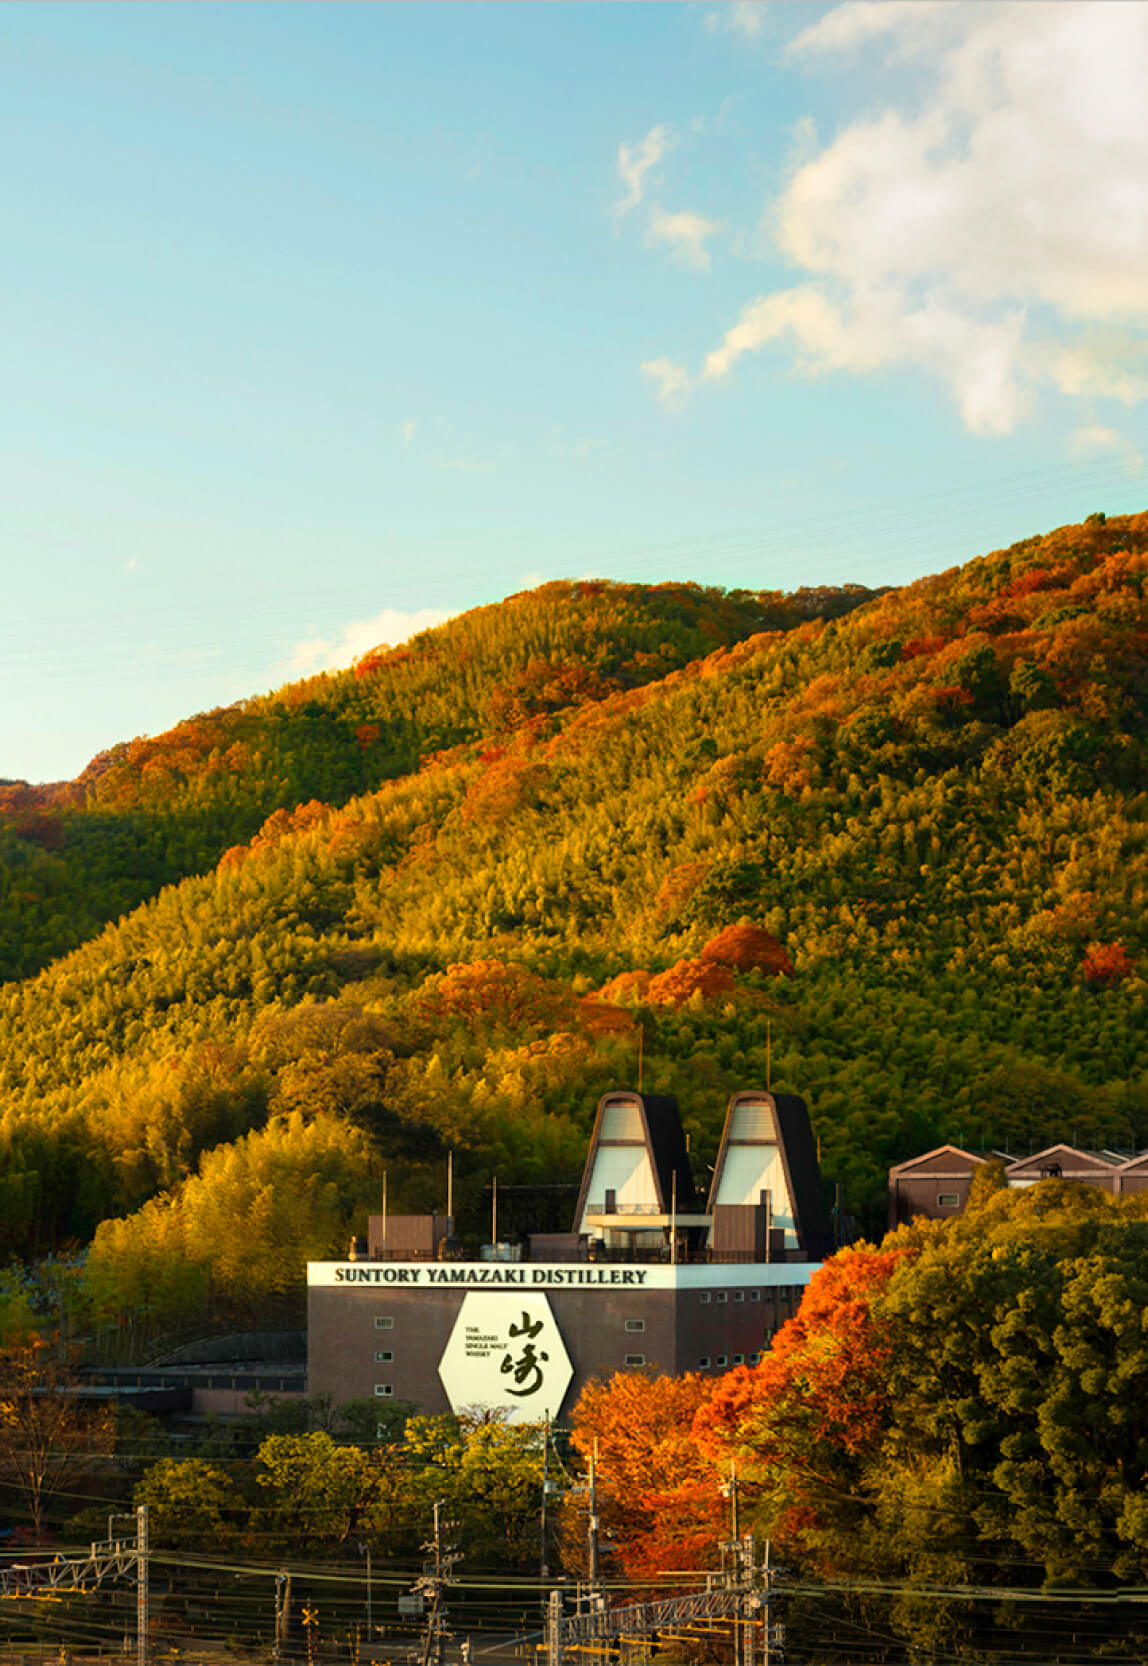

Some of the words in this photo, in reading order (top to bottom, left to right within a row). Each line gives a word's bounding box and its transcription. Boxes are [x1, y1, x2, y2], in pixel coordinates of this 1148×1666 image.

[334, 1267, 420, 1283] SUNTORY
[427, 1268, 525, 1284] YAMAZAKI
[532, 1269, 647, 1284] DISTILLERY
[500, 1310, 549, 1396] 山崎
